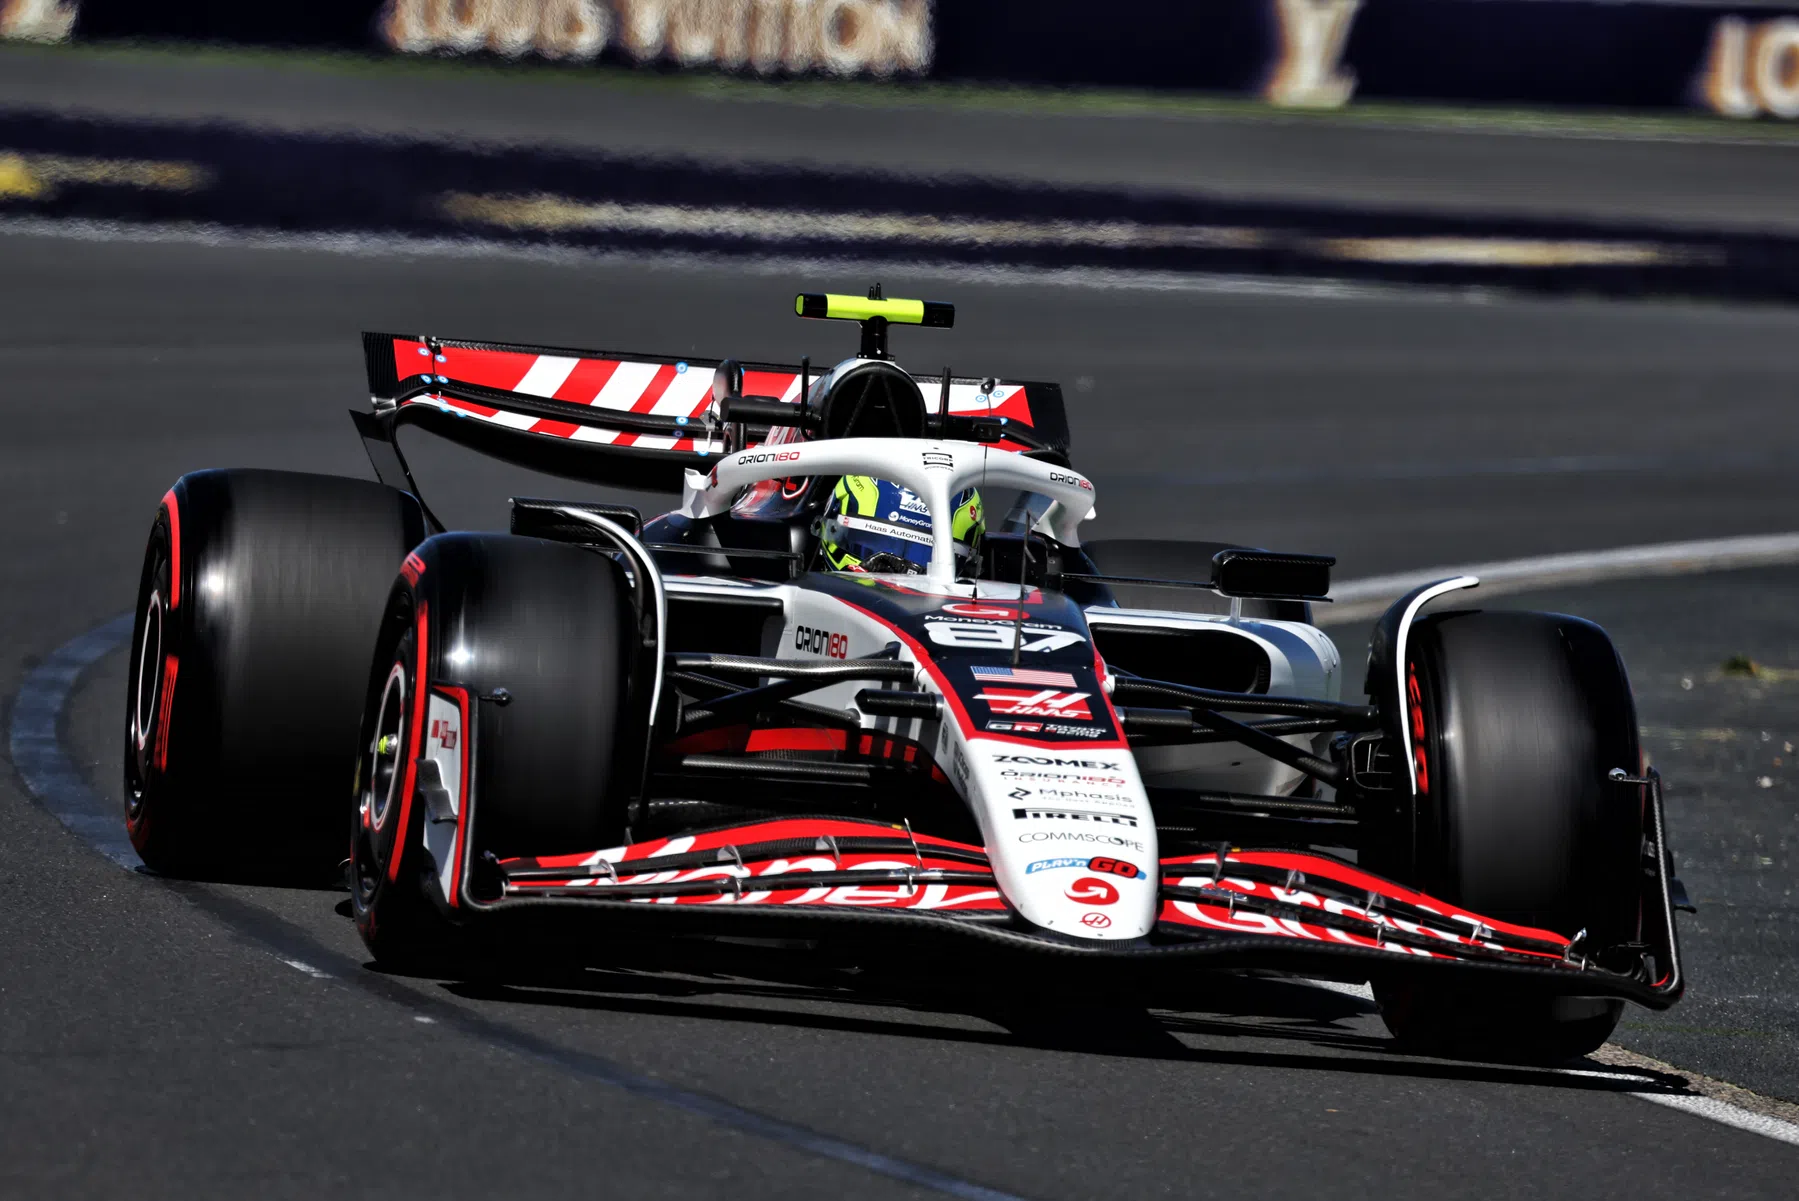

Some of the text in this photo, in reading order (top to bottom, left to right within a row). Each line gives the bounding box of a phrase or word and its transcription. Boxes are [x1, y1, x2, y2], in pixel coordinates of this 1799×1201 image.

[738, 451, 801, 466] ORION180
[864, 523, 888, 533] Haas
[796, 625, 848, 660] ORION180
[923, 622, 1087, 653] 87
[991, 705, 1091, 718] HAAS
[992, 755, 1121, 771] ZOOMEX
[1039, 788, 1133, 803] Mphasis
[1012, 808, 1138, 828] PIRELLI
[1019, 832, 1144, 853] COMMSCOPE
